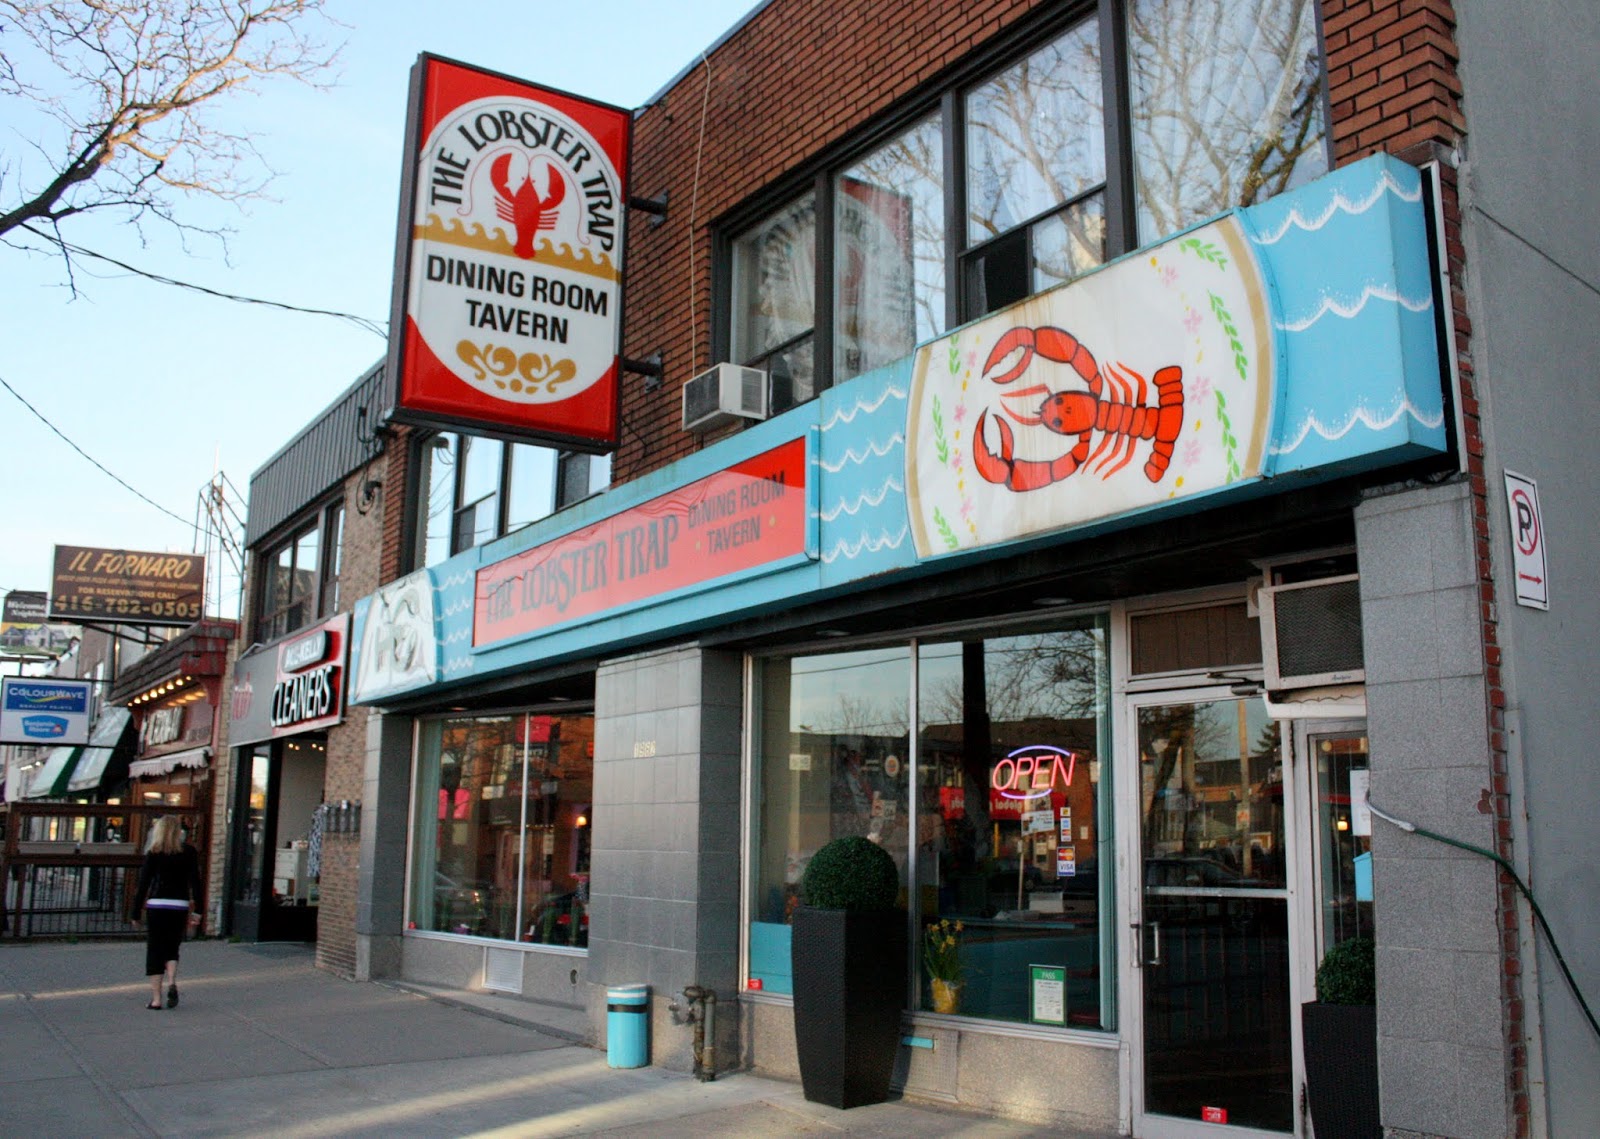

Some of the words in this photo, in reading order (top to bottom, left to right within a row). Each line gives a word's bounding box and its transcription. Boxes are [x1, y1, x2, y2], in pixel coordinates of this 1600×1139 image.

[431, 146, 470, 206] THE
[457, 109, 591, 174] LOBSTER
[580, 169, 615, 253] TRAP
[427, 254, 525, 298] DINING
[532, 275, 608, 317] ROOM
[466, 299, 569, 344] TAVERN
[687, 488, 737, 530] DINING
[740, 470, 786, 509] ROOM
[68, 551, 93, 572] IL
[93, 552, 192, 579] FORNARO
[706, 516, 762, 554] TAVERN
[486, 577, 515, 624] THE
[521, 539, 608, 614] LOBSTER
[615, 513, 680, 582] TRAP
[270, 664, 333, 728] CLEANERS
[992, 753, 1076, 791] OPEN
